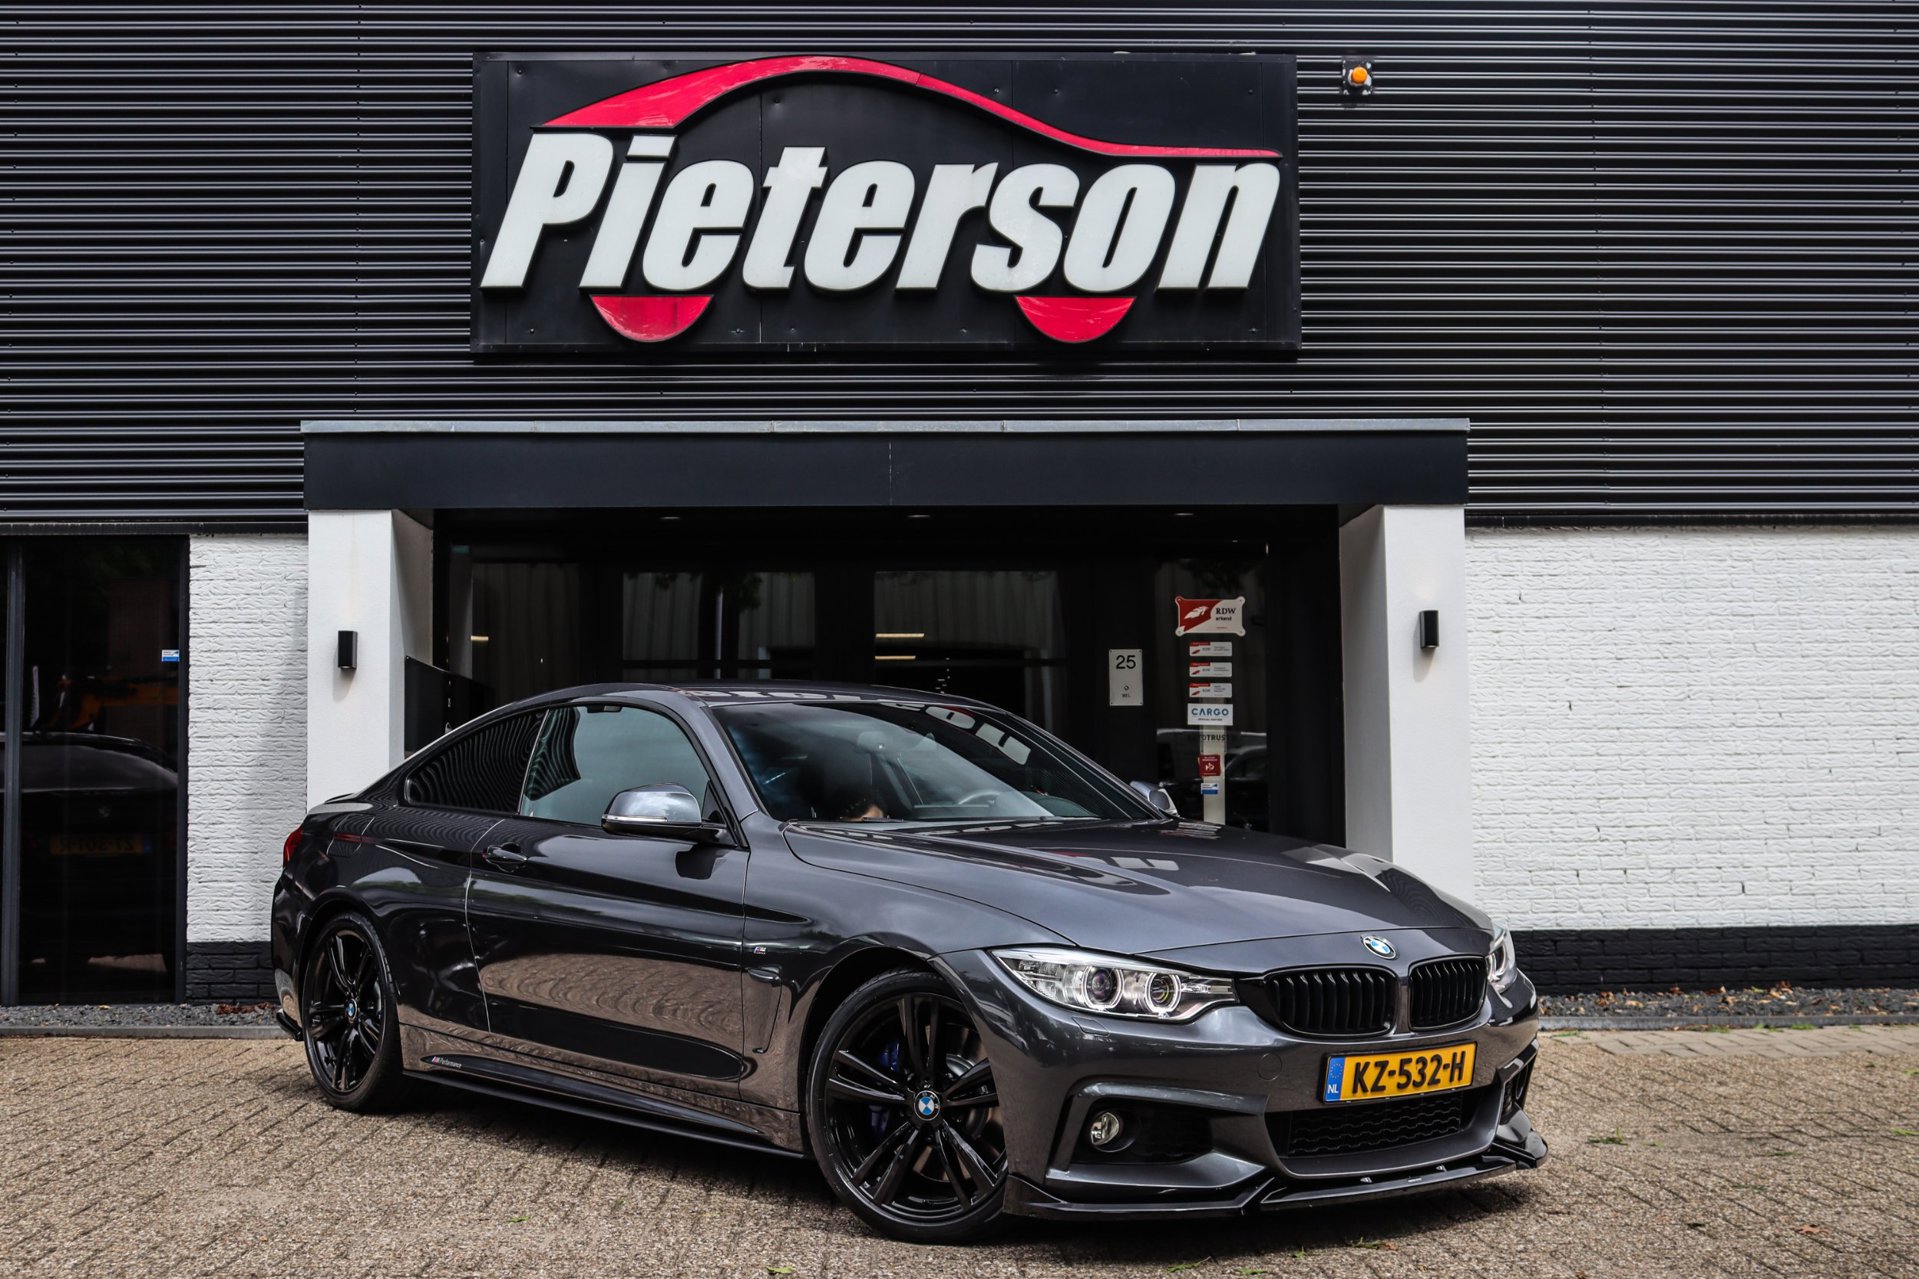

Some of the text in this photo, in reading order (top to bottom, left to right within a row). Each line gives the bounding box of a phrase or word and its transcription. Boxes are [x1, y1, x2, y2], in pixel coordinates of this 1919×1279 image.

[480, 132, 1280, 292] Pieterson
[1216, 607, 1236, 615] RDW
[1116, 655, 1136, 669] 25
[1192, 708, 1229, 716] CARGO
[1352, 1051, 1466, 1094] KZ-532-H
[1328, 1084, 1339, 1093] NL
